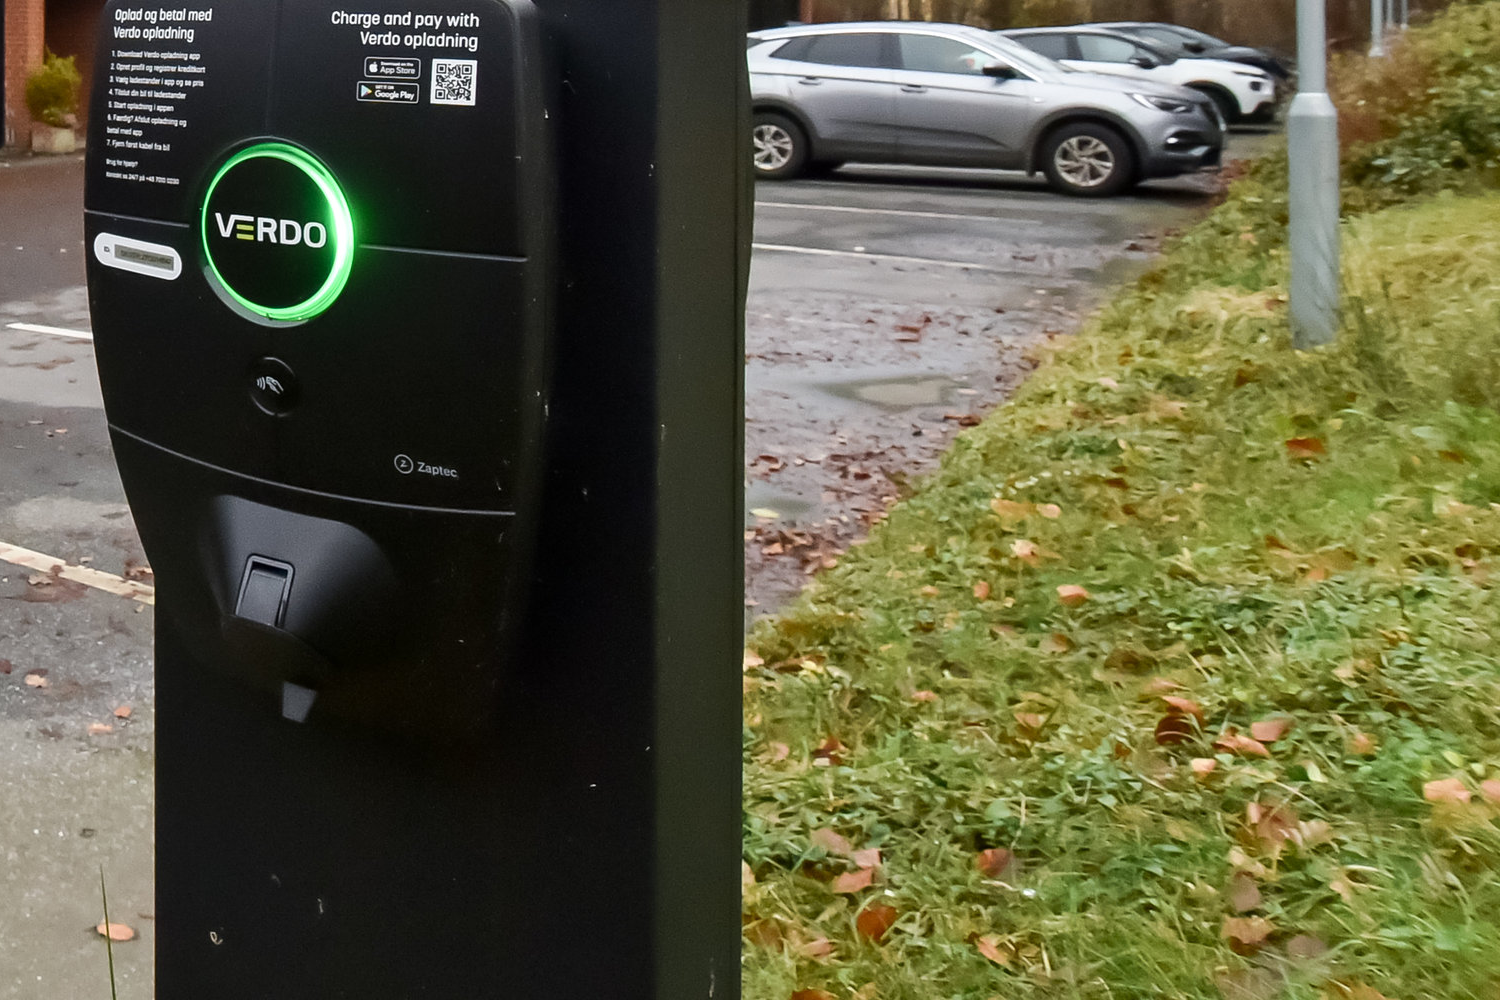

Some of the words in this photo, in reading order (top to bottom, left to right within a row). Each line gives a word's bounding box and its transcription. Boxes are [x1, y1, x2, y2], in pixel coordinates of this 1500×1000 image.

[115, 8, 143, 23] Oplad
[144, 10, 157, 24] og
[160, 8, 186, 21] betal
[188, 8, 212, 21] med
[331, 11, 380, 28] Charge
[384, 11, 411, 26] and
[415, 14, 443, 29] pay
[447, 13, 479, 27] with
[113, 26, 141, 38] Verdo
[143, 26, 194, 43] opladning
[360, 31, 400, 45] Verdo
[404, 32, 478, 52] opladning
[380, 66, 395, 74] App
[396, 67, 416, 75] Store
[374, 90, 400, 100] Google
[400, 91, 415, 100] Play
[214, 212, 327, 249] VERDO
[417, 461, 458, 478] Zaptec
